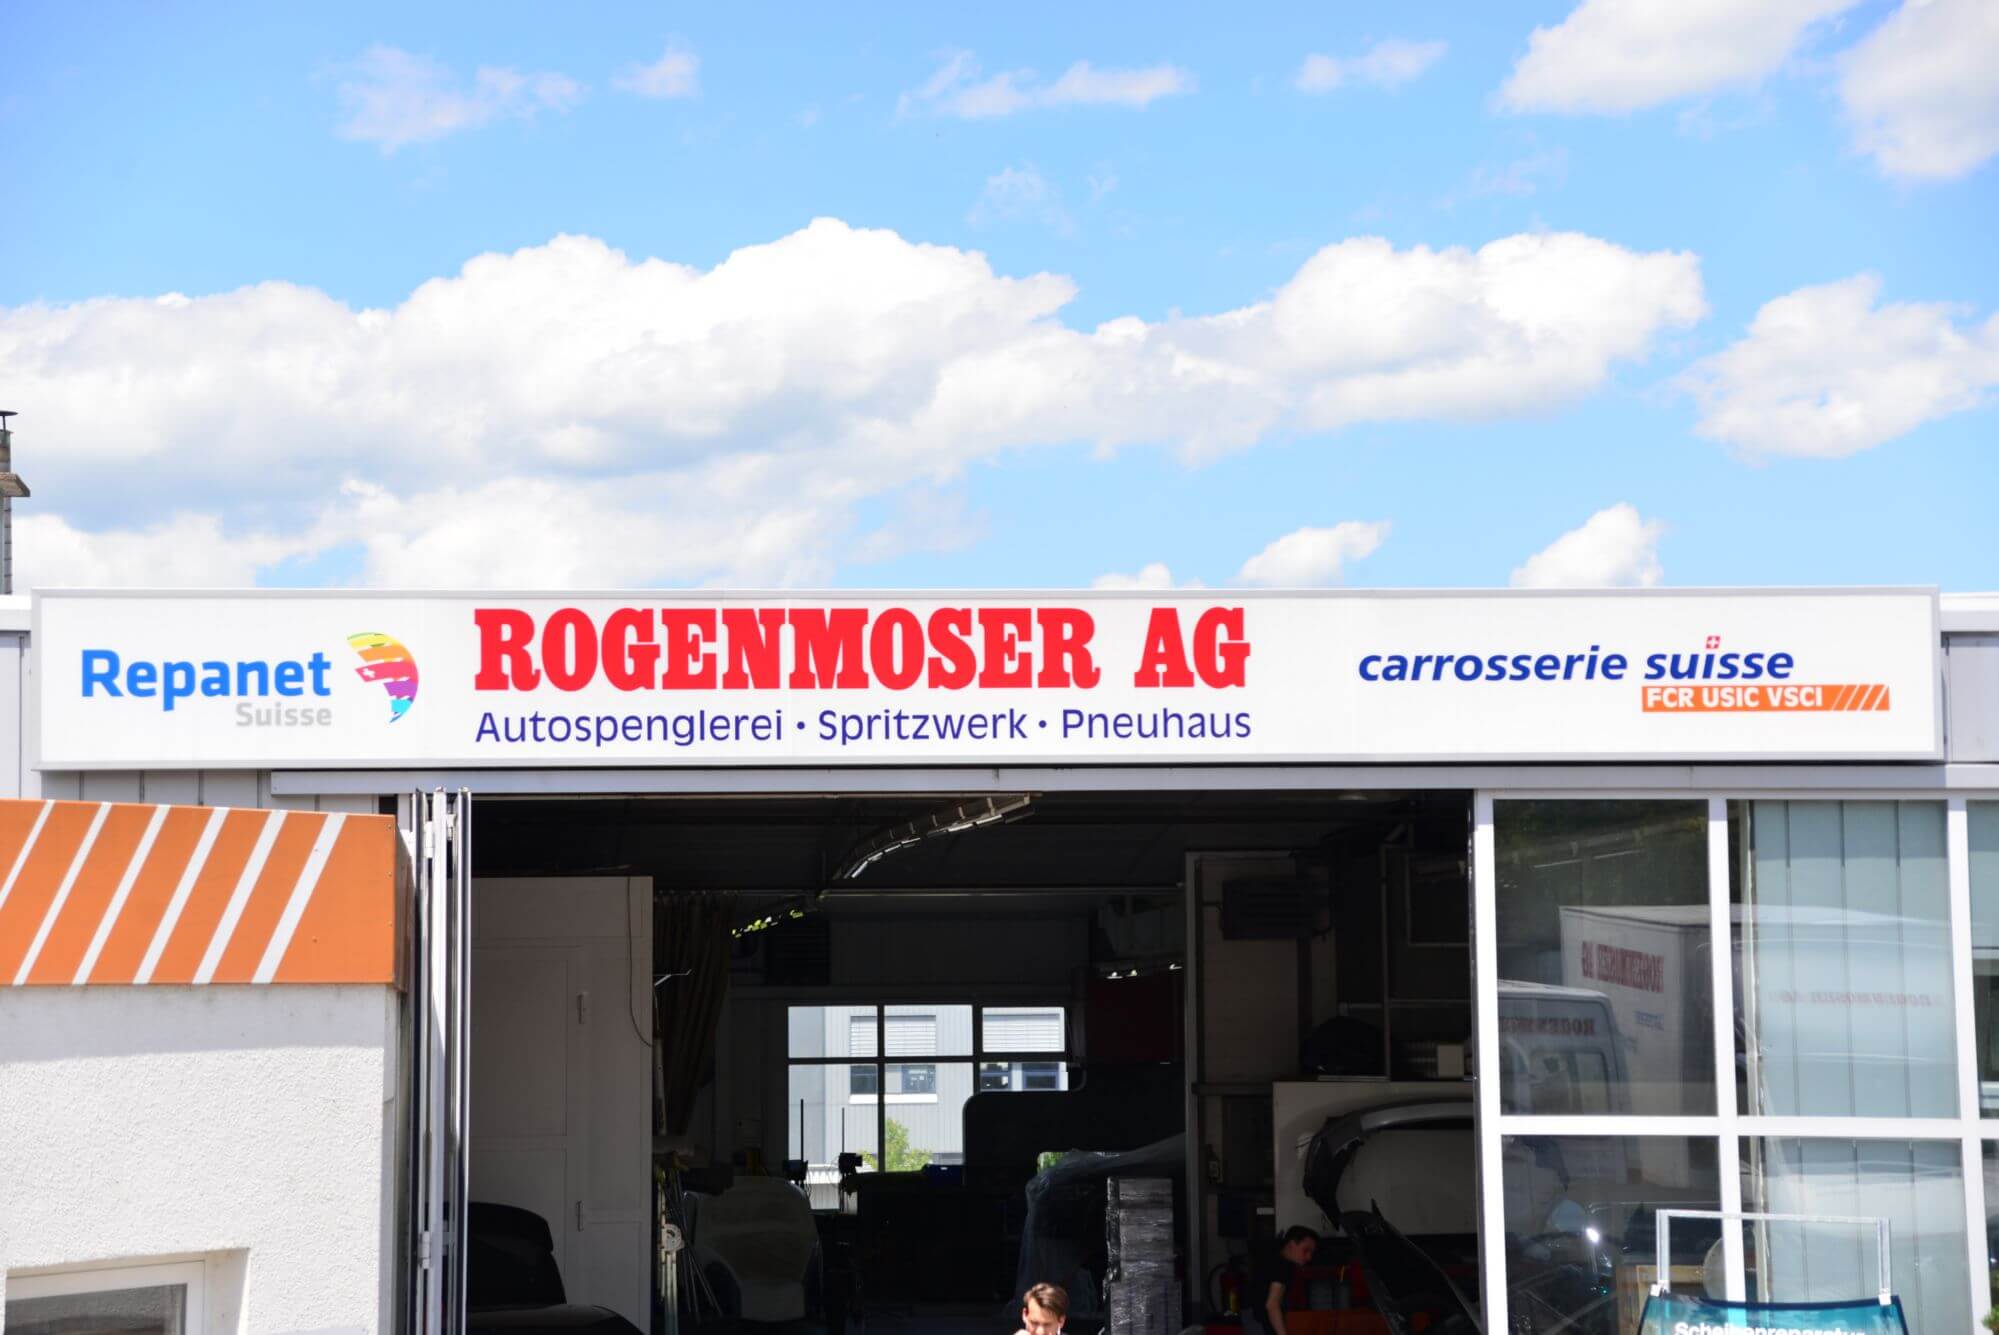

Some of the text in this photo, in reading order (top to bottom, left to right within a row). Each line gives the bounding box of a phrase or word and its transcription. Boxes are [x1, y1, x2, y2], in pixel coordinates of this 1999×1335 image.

[474, 606, 1252, 692] ROGENMOSER AG
[1358, 635, 1796, 682] carrosserie suisse
[81, 648, 333, 713] Repanet
[1646, 686, 1822, 709] FCR USIC VSCI
[235, 701, 333, 728] Suisse
[475, 708, 1251, 748] Autospenglerei Spritzwerk Pneuhaus
